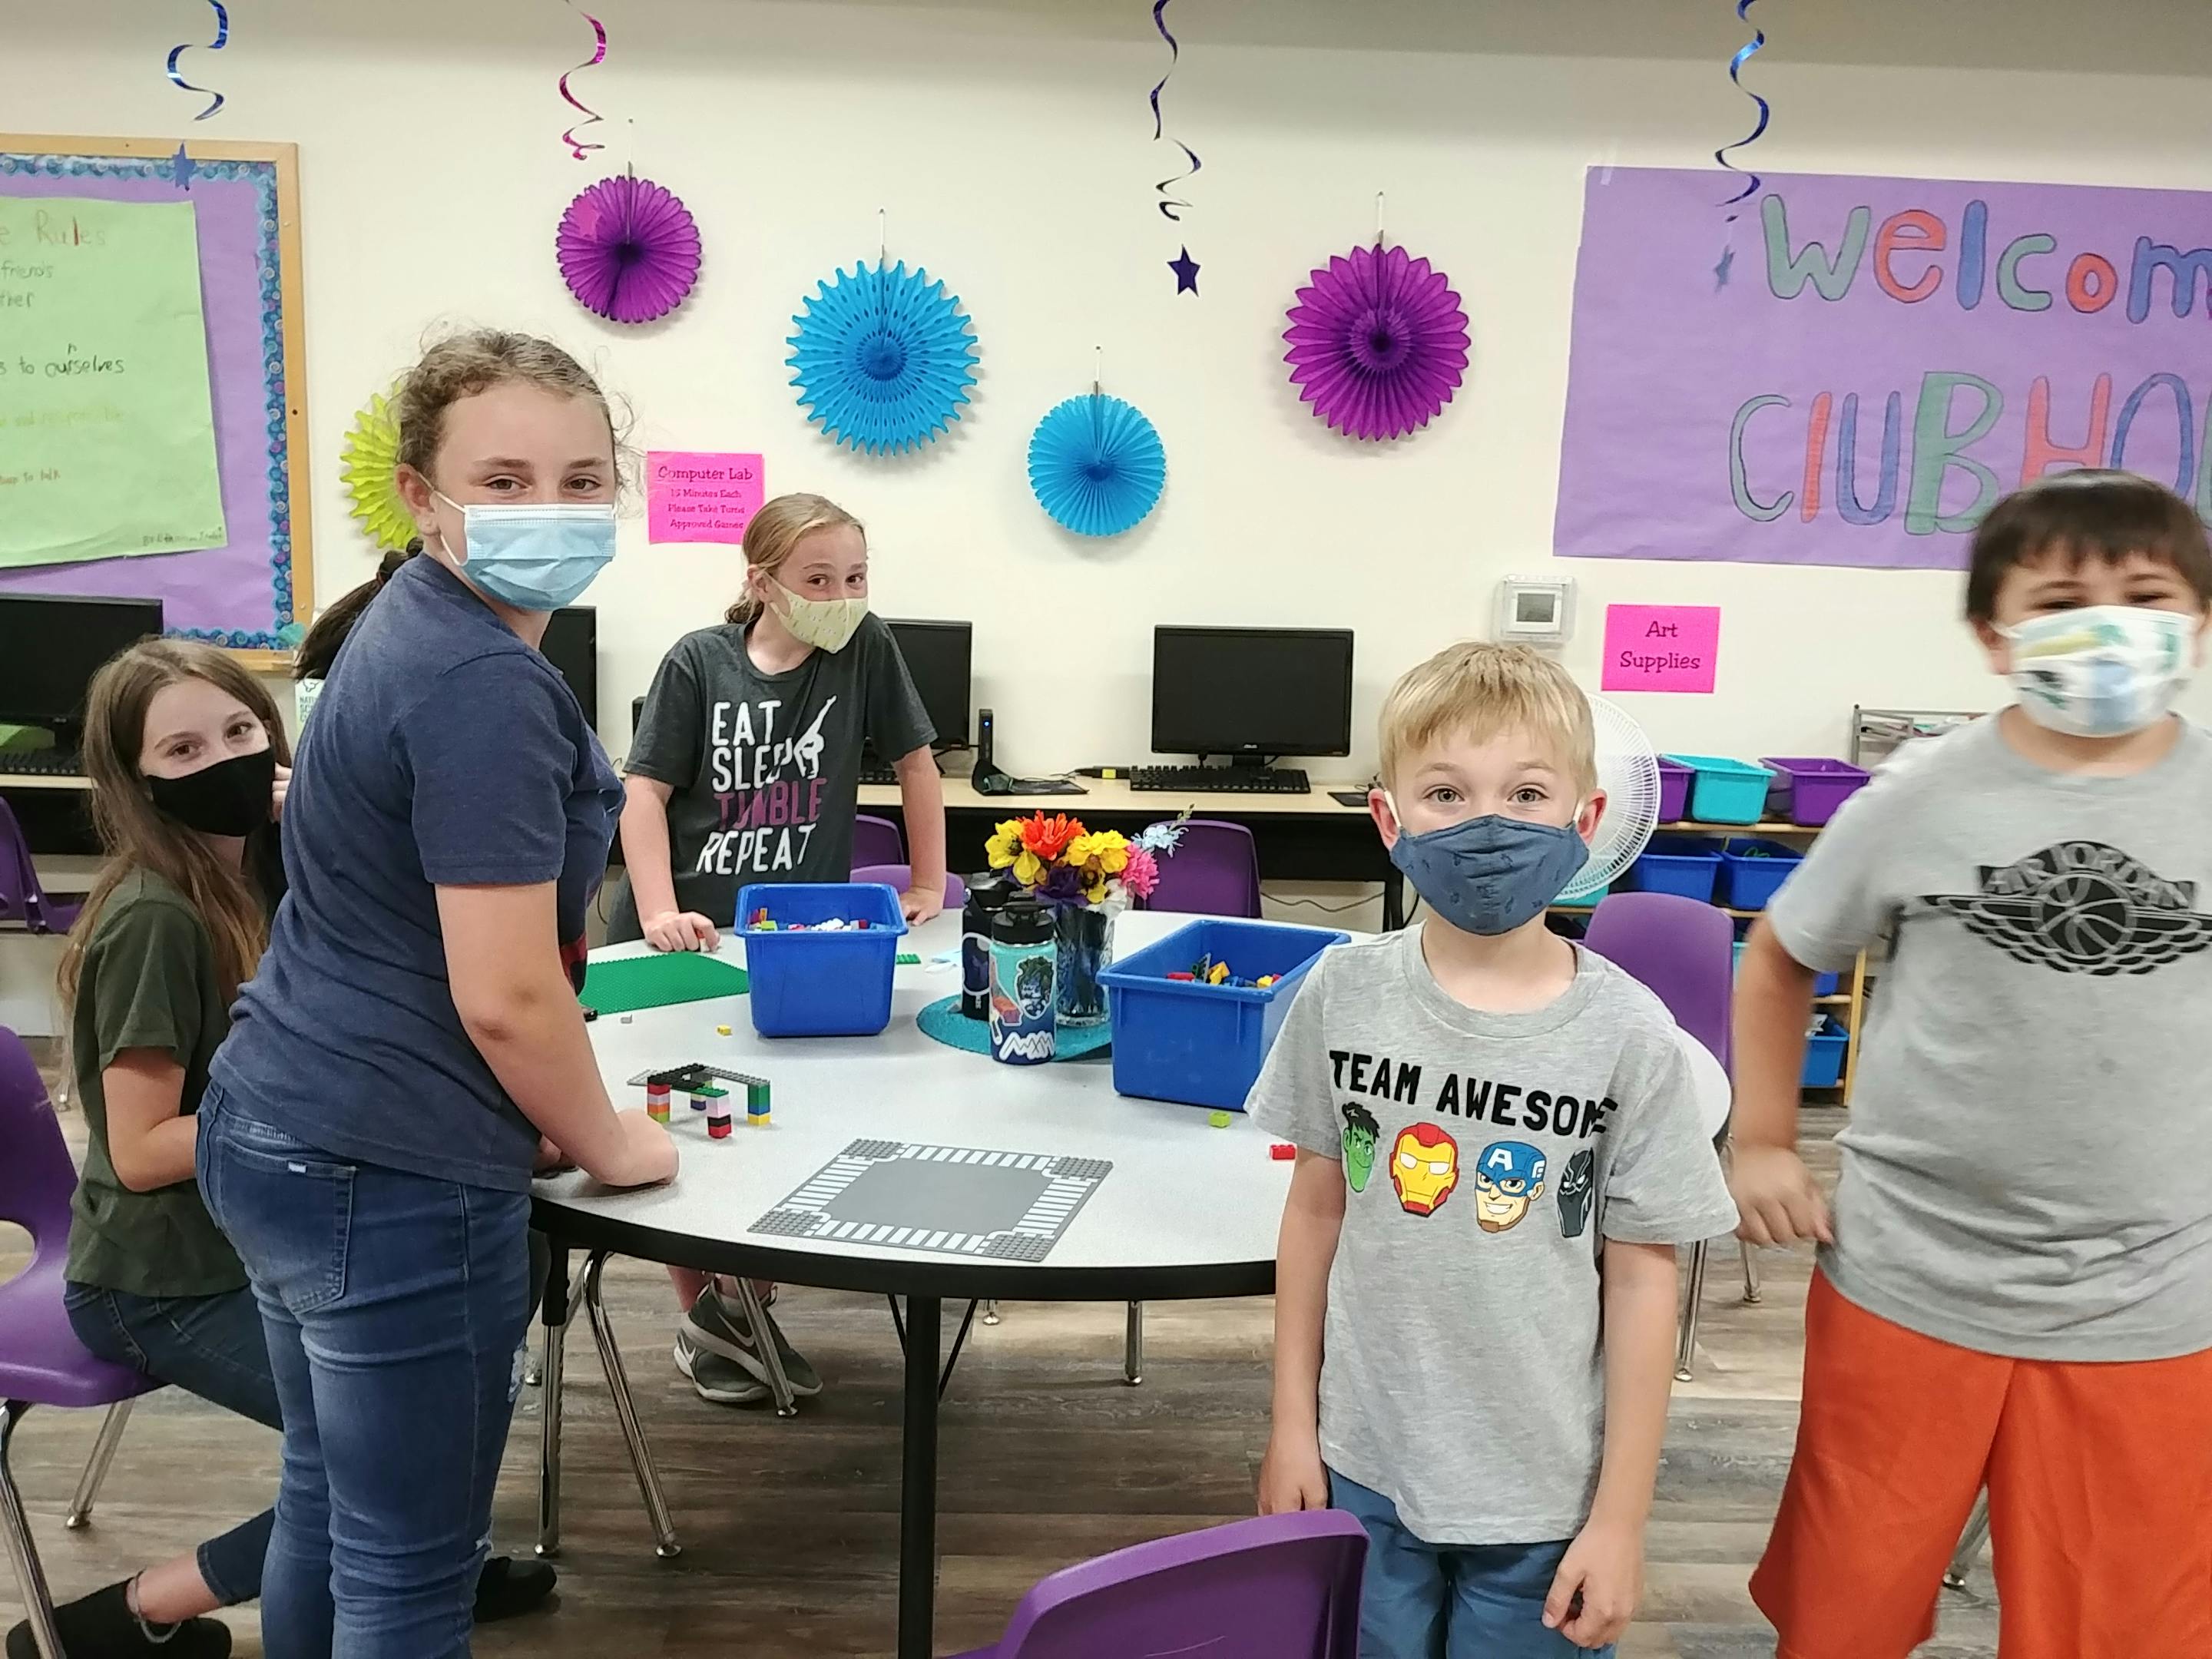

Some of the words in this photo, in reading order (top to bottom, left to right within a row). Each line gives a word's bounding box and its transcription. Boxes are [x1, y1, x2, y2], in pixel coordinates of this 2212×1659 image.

[35, 209, 106, 247] Rules
[19, 356, 35, 375] to
[658, 466, 725, 482] Computer
[730, 468, 753, 480] Lab
[671, 488, 681, 498] 15
[683, 488, 718, 498] Minutes
[720, 490, 742, 498] Each
[667, 504, 696, 512] Please
[697, 505, 719, 513] Take
[720, 505, 745, 514] Turns
[670, 519, 713, 530] Approved
[714, 520, 743, 529] Games
[1645, 621, 1678, 637] Art
[1620, 651, 1700, 674] Supplies
[711, 700, 782, 747] EAT
[696, 823, 816, 876] REPEAT
[1330, 1050, 1422, 1104] TEAM
